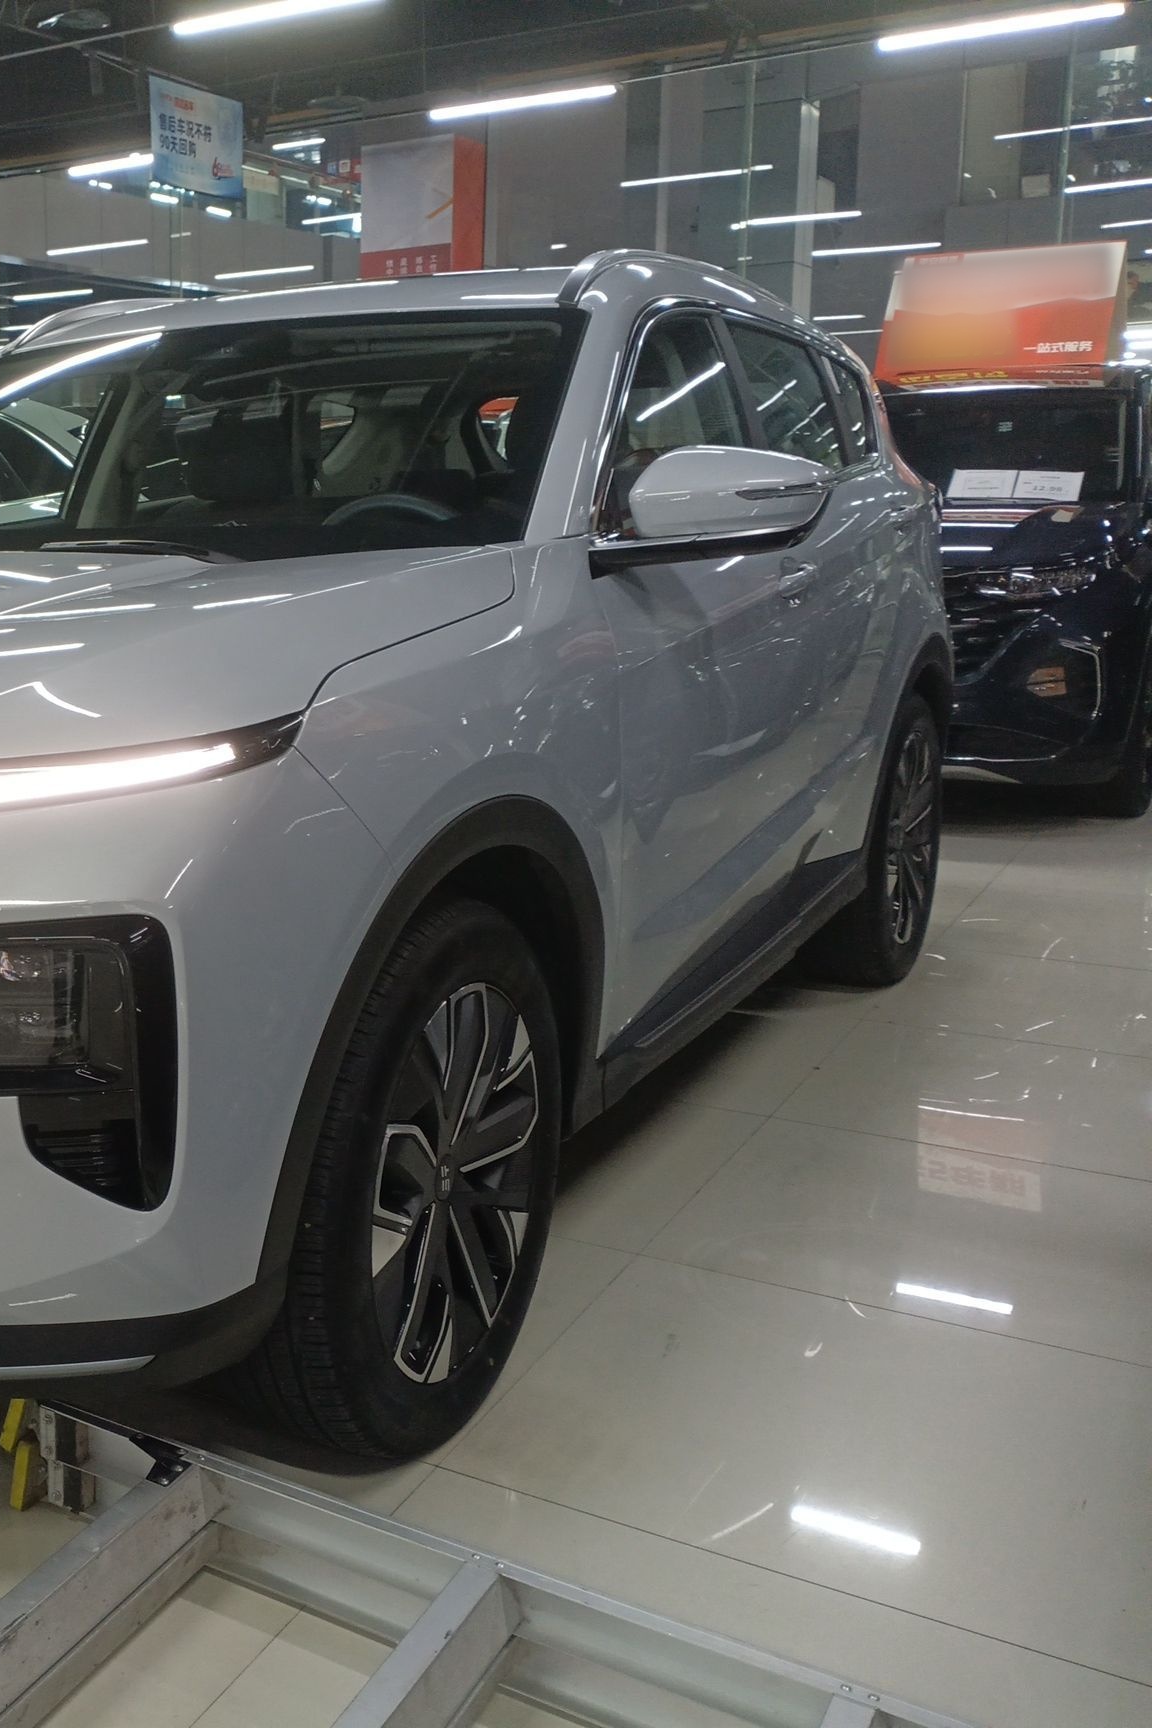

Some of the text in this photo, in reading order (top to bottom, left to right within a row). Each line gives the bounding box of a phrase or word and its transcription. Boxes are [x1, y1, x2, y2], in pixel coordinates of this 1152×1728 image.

[1023, 340, 1093, 354] 一站式服务
